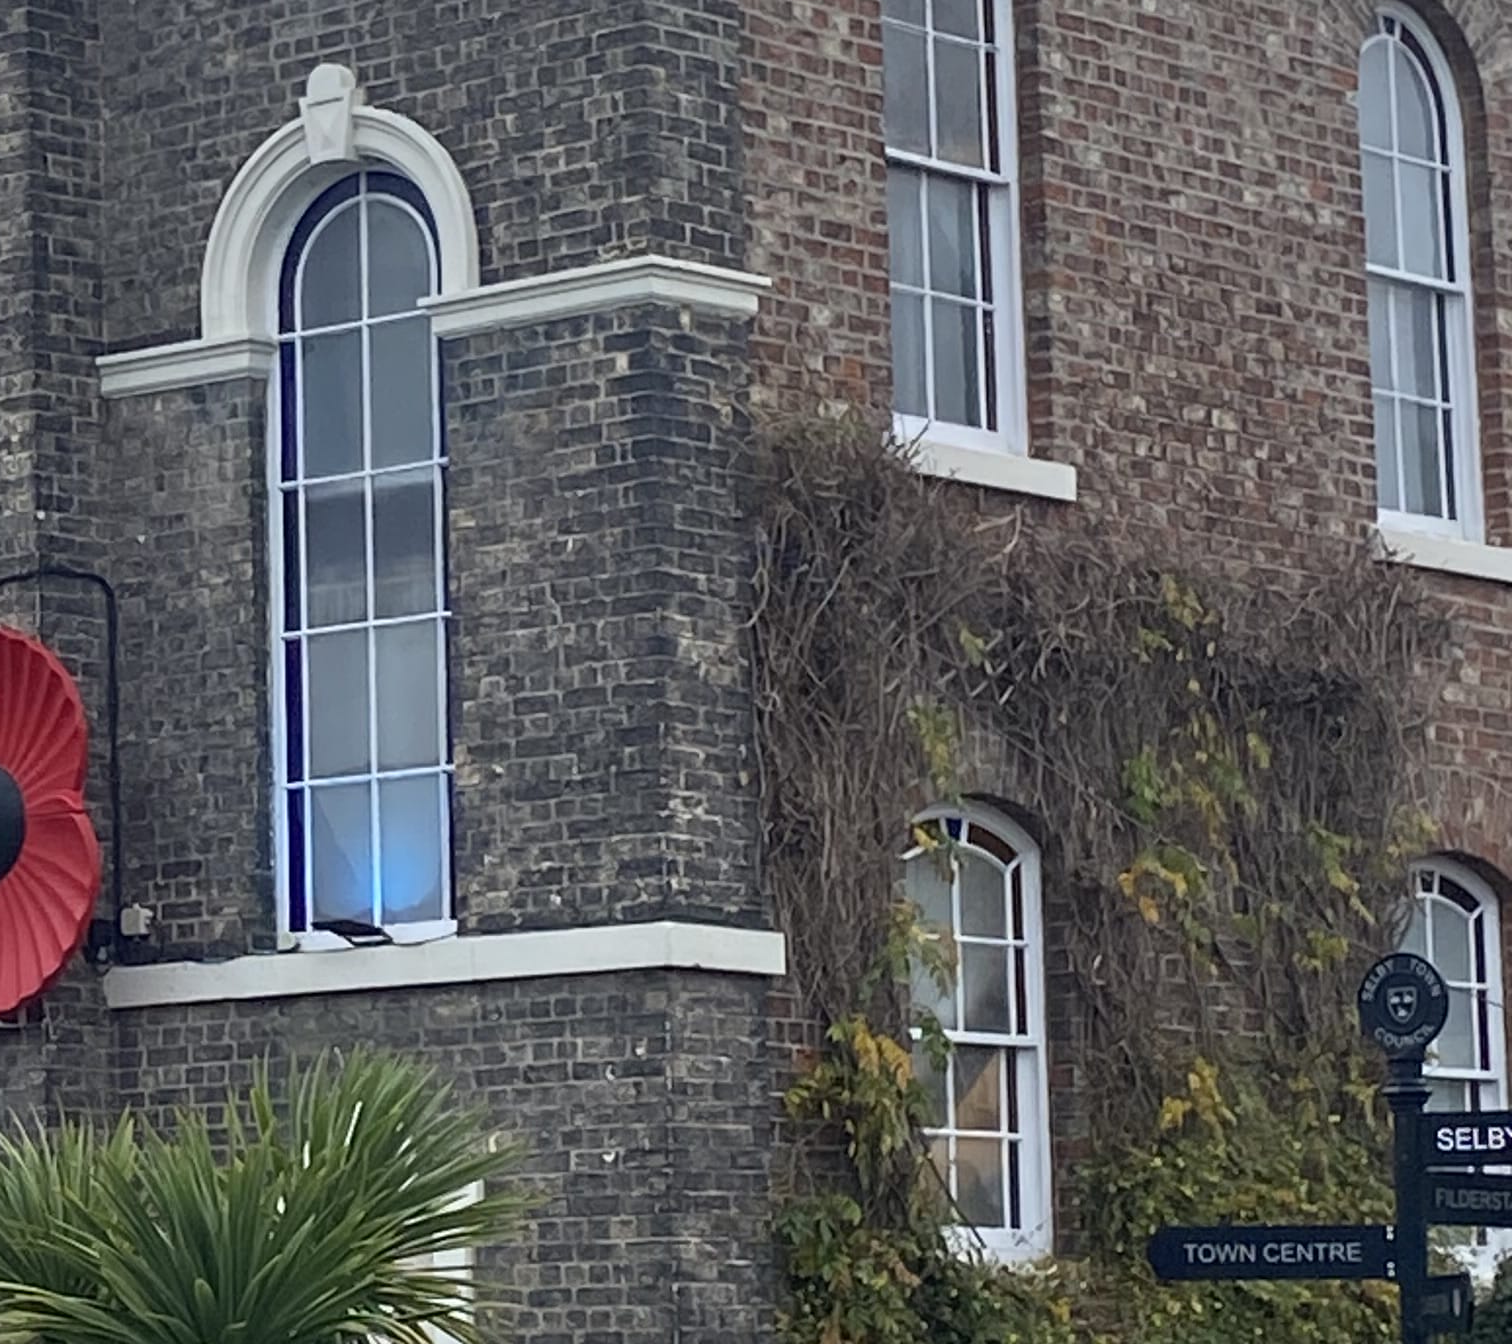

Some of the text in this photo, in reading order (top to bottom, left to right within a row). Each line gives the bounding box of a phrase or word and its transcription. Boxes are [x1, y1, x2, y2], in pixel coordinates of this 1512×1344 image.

[1361, 958, 1441, 1002] SELBY TOWN
[1374, 1024, 1435, 1049] COUNCIL
[1434, 1187, 1512, 1211] FILDERST
[1182, 1241, 1363, 1264] TOWN CENTRE
